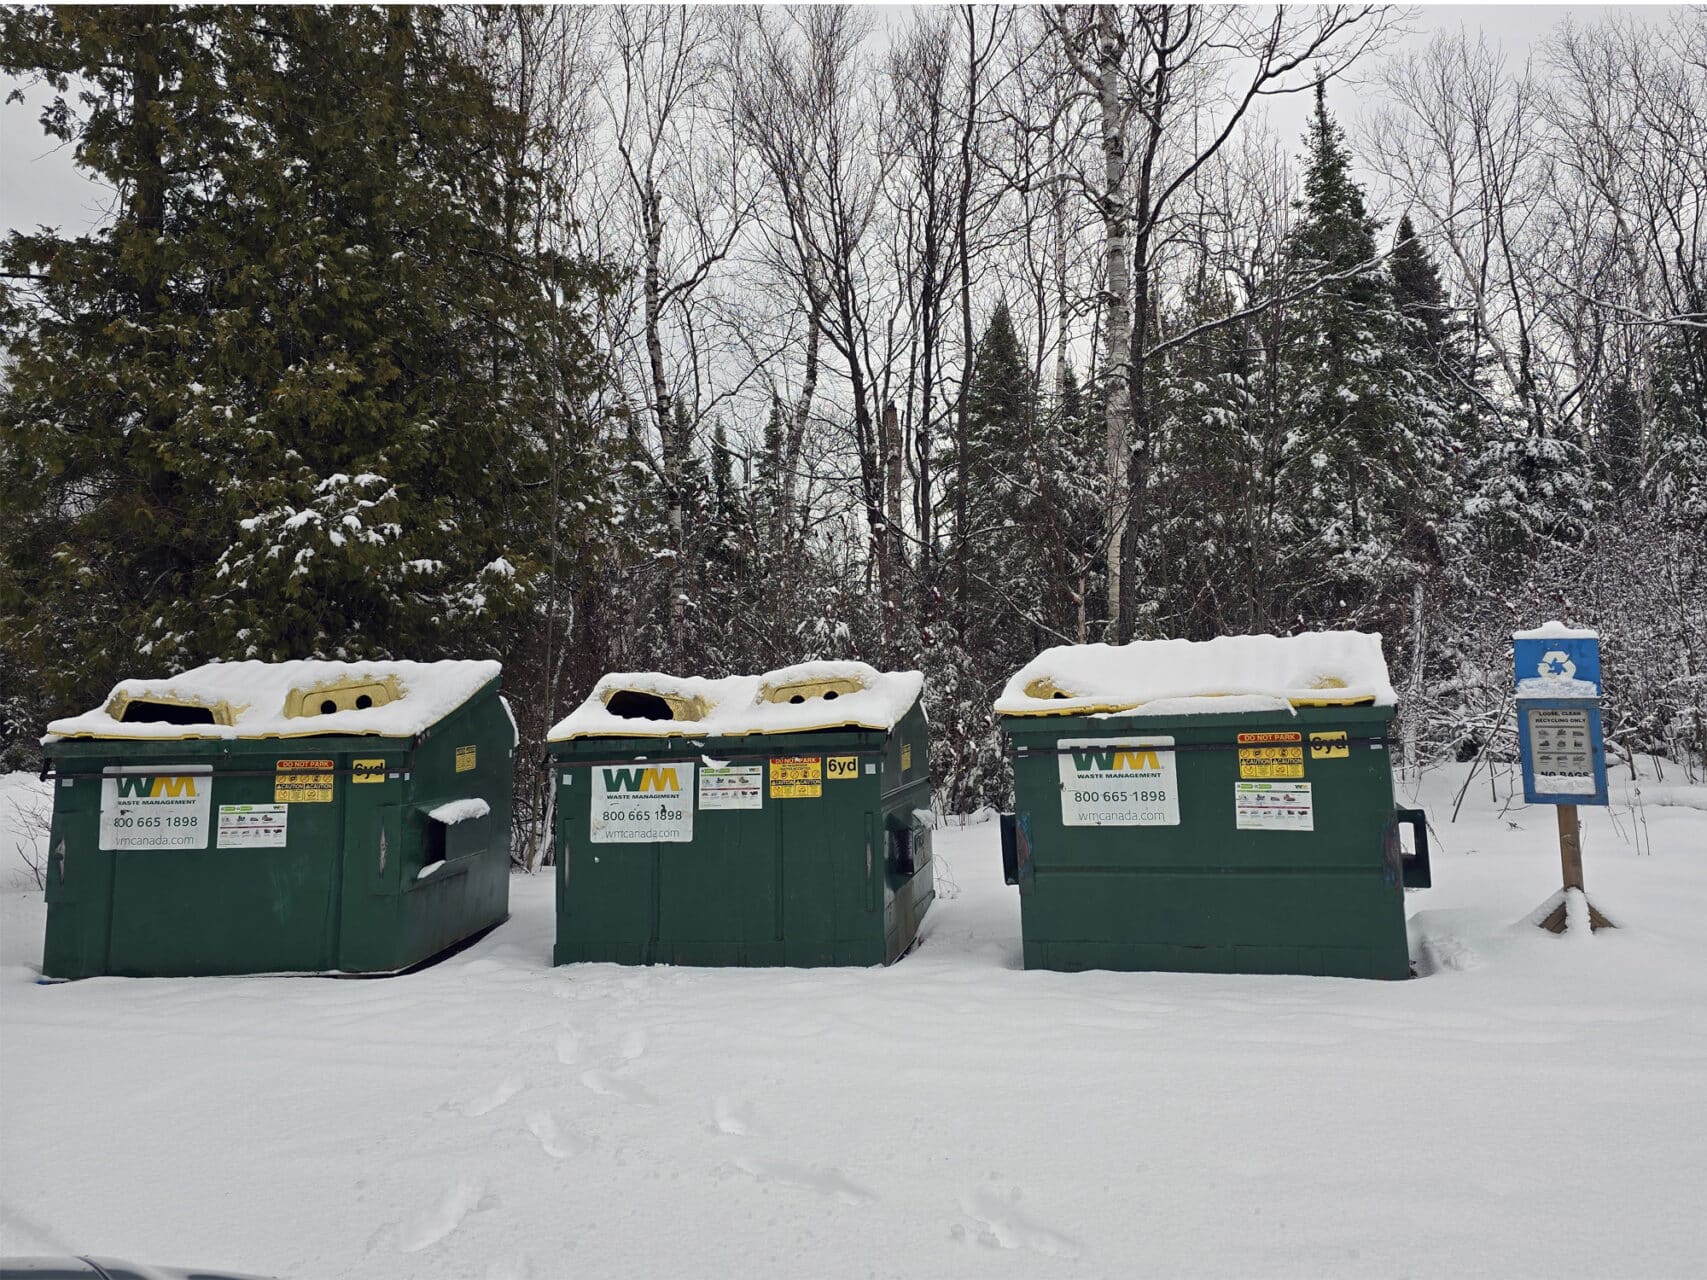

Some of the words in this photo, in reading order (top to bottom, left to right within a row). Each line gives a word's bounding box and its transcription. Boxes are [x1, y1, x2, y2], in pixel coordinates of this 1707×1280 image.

[1312, 734, 1346, 754] 6yd
[1070, 744, 1160, 772] WM
[354, 763, 384, 779] 6yd
[828, 758, 856, 775] 6yd
[116, 776, 196, 798] WM
[602, 768, 680, 792] WM
[1074, 792, 1100, 802] 800
[1103, 791, 1128, 802] 665
[1132, 790, 1166, 802] 1898
[114, 817, 134, 828] 800
[137, 817, 161, 827] 665
[166, 816, 198, 827] 1898
[602, 811, 625, 821] 800
[628, 811, 650, 821] 665
[655, 810, 682, 821] 1898
[1078, 810, 1165, 821] wmcanada.com
[605, 829, 680, 839] wmcanada.com
